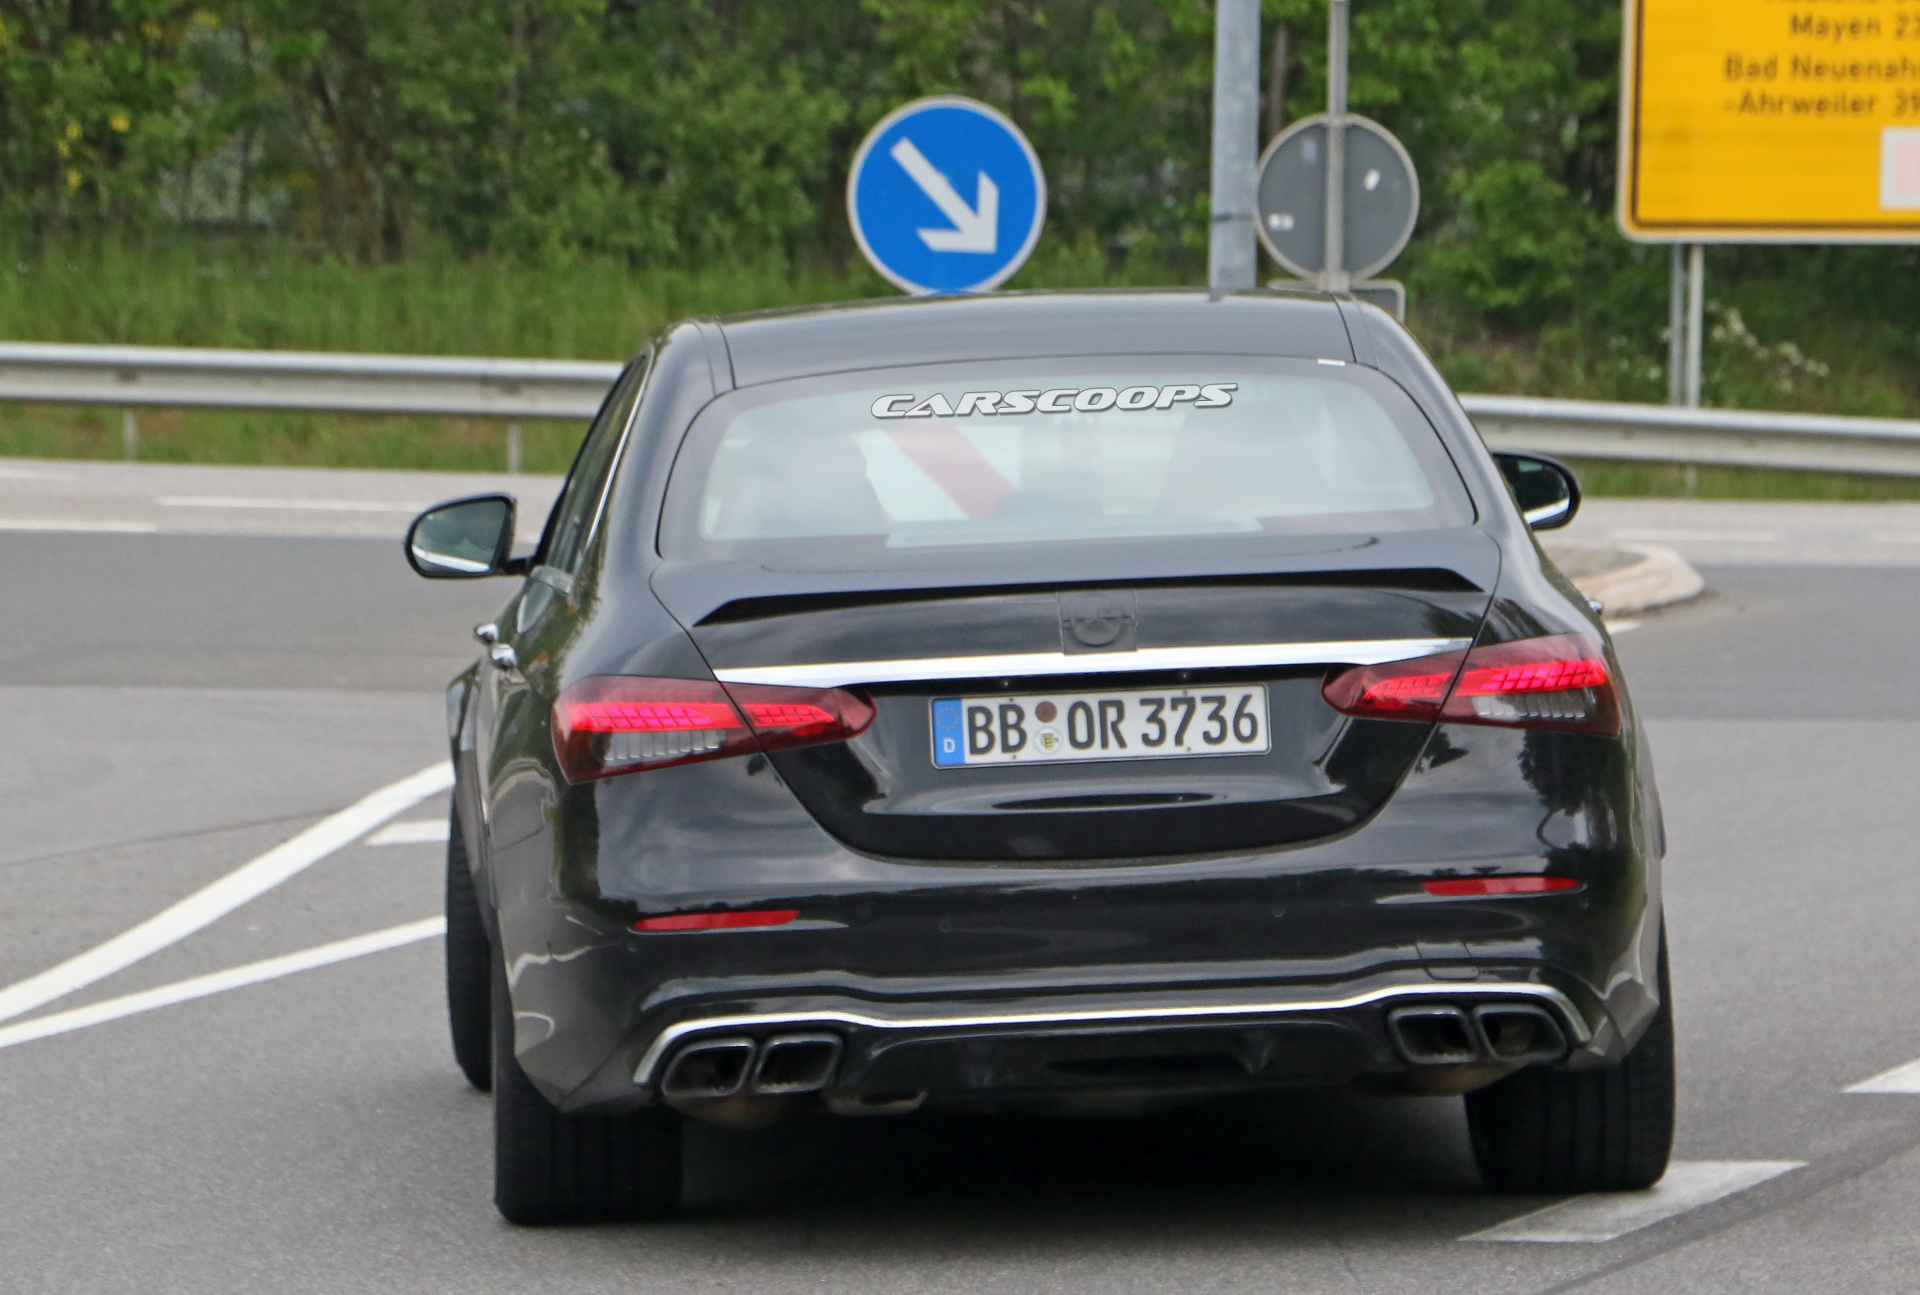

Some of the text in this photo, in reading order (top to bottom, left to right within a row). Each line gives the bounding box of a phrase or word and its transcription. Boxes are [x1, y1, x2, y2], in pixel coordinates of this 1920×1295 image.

[1789, 12, 1881, 43] Mayen
[1724, 51, 1920, 81] Bad Neuenah
[943, 694, 1259, 755] D BB OR 3736
